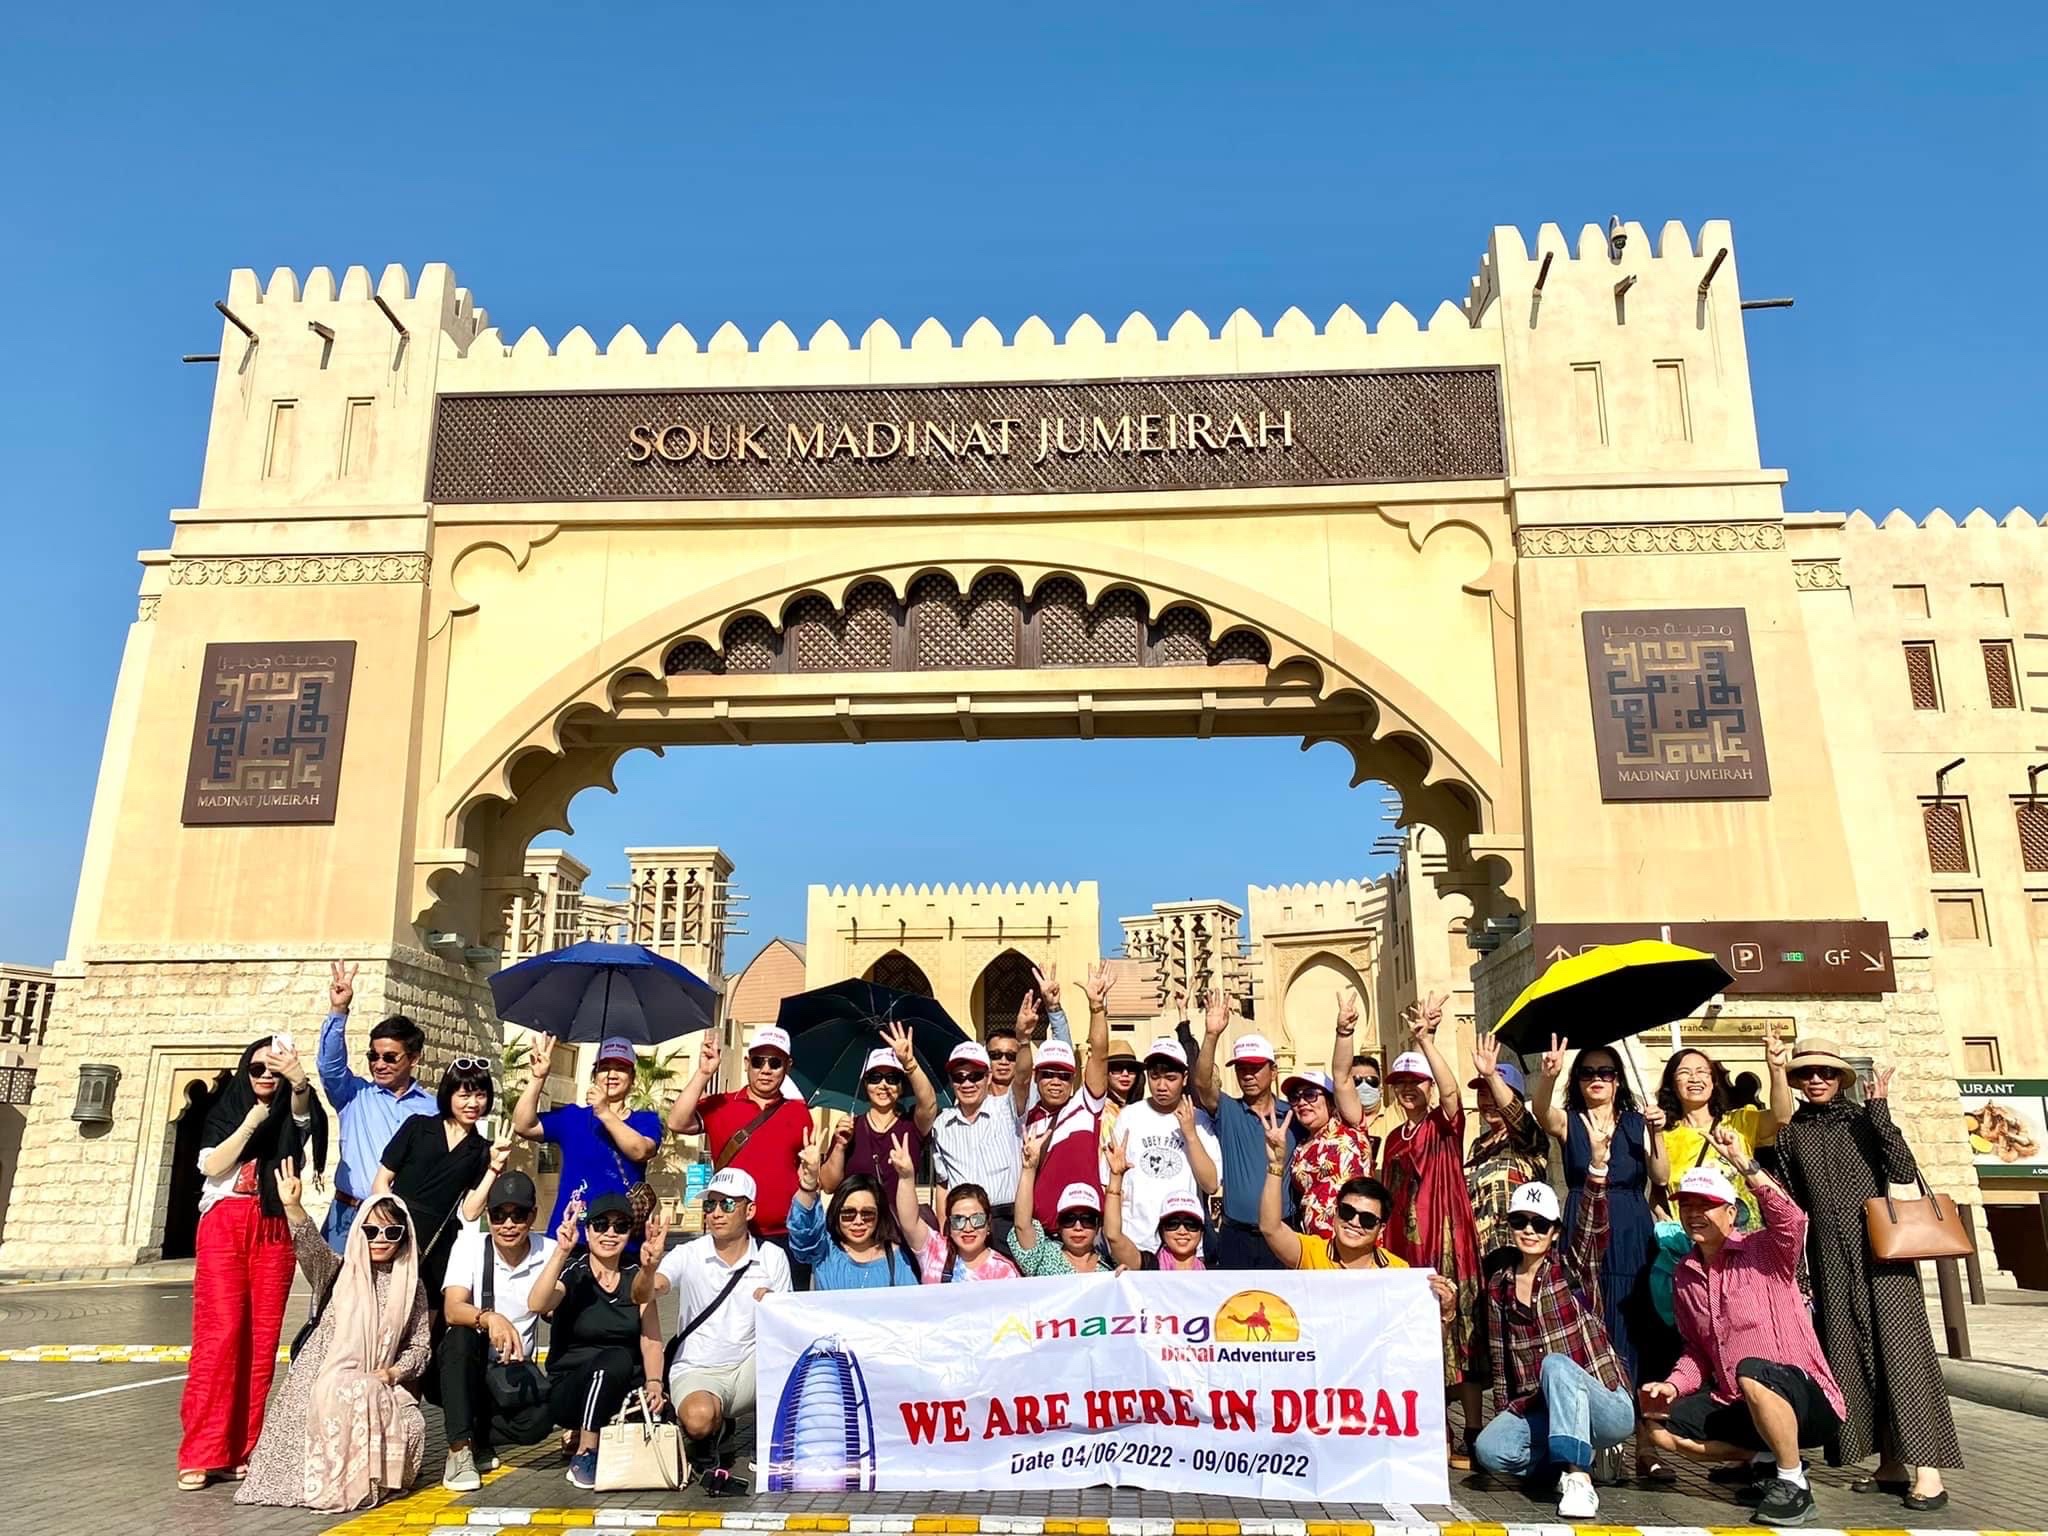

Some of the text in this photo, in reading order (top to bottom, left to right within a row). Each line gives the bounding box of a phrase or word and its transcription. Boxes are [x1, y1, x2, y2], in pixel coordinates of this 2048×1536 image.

[627, 410, 1293, 463] SOUK MADINAT JUMEIRAH
[1618, 768, 1753, 783] MADINAT JUMEIRAH
[197, 794, 320, 808] MADINAT JUMEIRAH
[1739, 949, 1754, 967] P
[1825, 949, 1850, 966] GF
[1668, 1023, 1710, 1032] trance
[992, 1308, 1210, 1343] Amazing
[1217, 1347, 1317, 1363] Adventures
[899, 1388, 1420, 1446] WE ARE HERE IN DUBAI
[1010, 1450, 1055, 1475] Date
[1062, 1441, 1173, 1469] 04/06/2022
[1192, 1448, 1310, 1478] 09/06/2022
